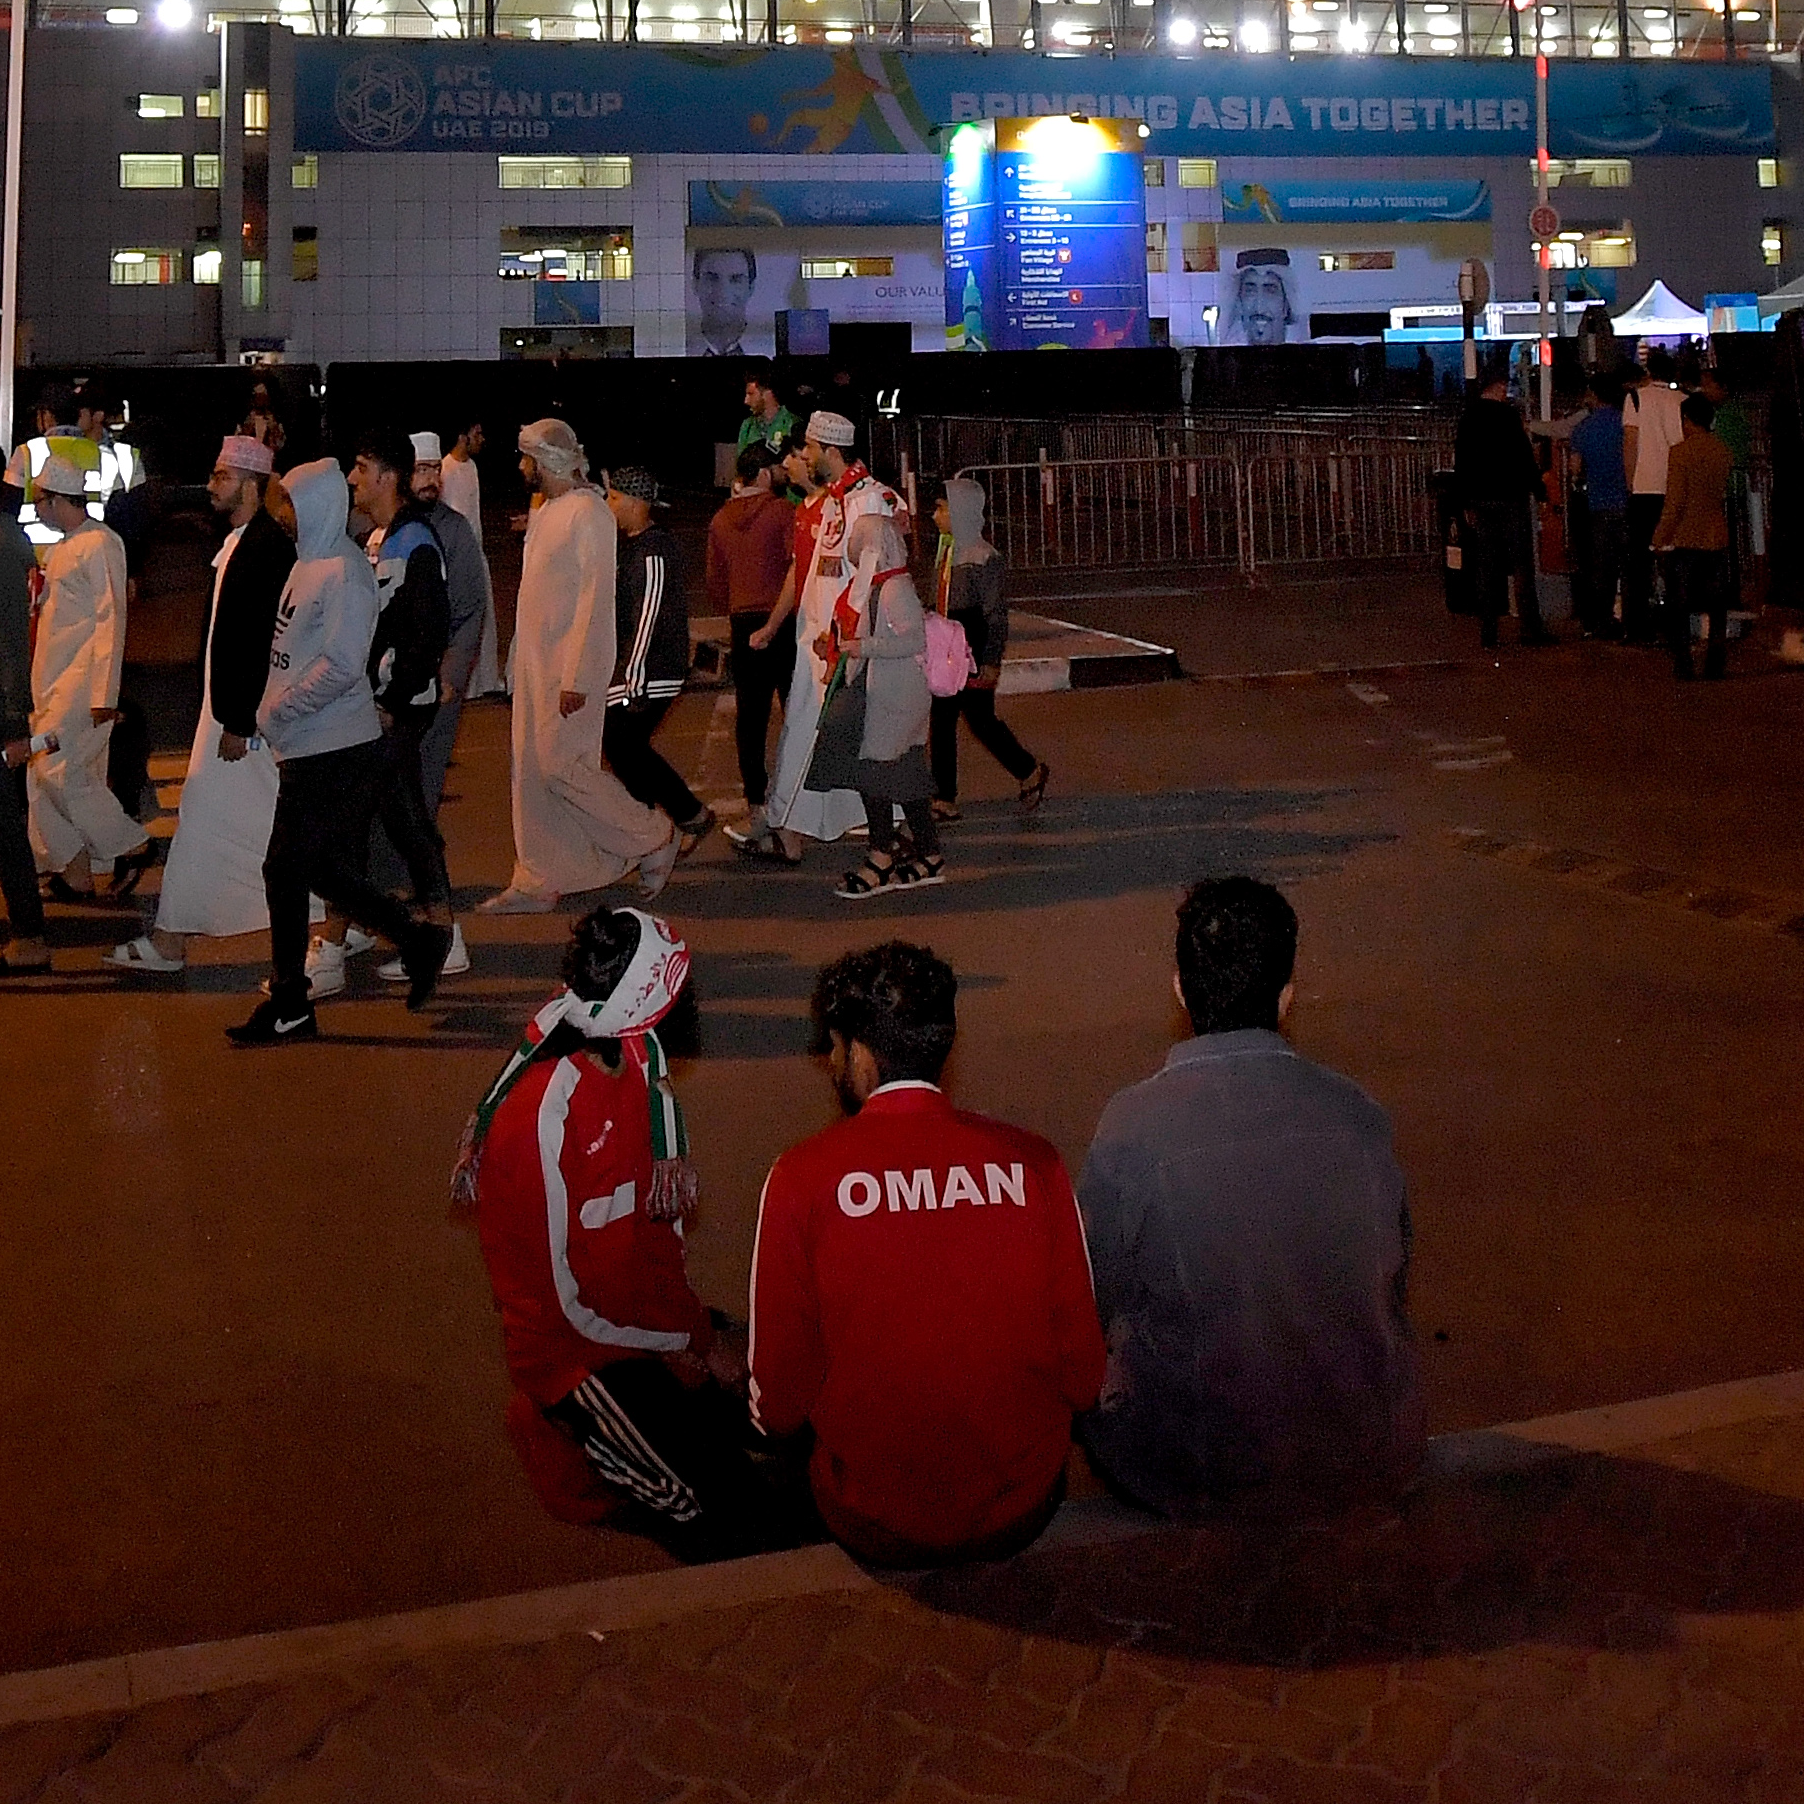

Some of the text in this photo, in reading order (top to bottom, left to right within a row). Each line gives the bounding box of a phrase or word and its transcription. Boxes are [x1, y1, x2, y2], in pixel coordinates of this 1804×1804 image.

[433, 89, 624, 119] ASIAN CUP
[1188, 95, 1294, 131] ASIA
[1302, 96, 1530, 132] TOGETHER
[875, 286, 907, 298] OUR
[837, 1162, 1026, 1218] OMAN
